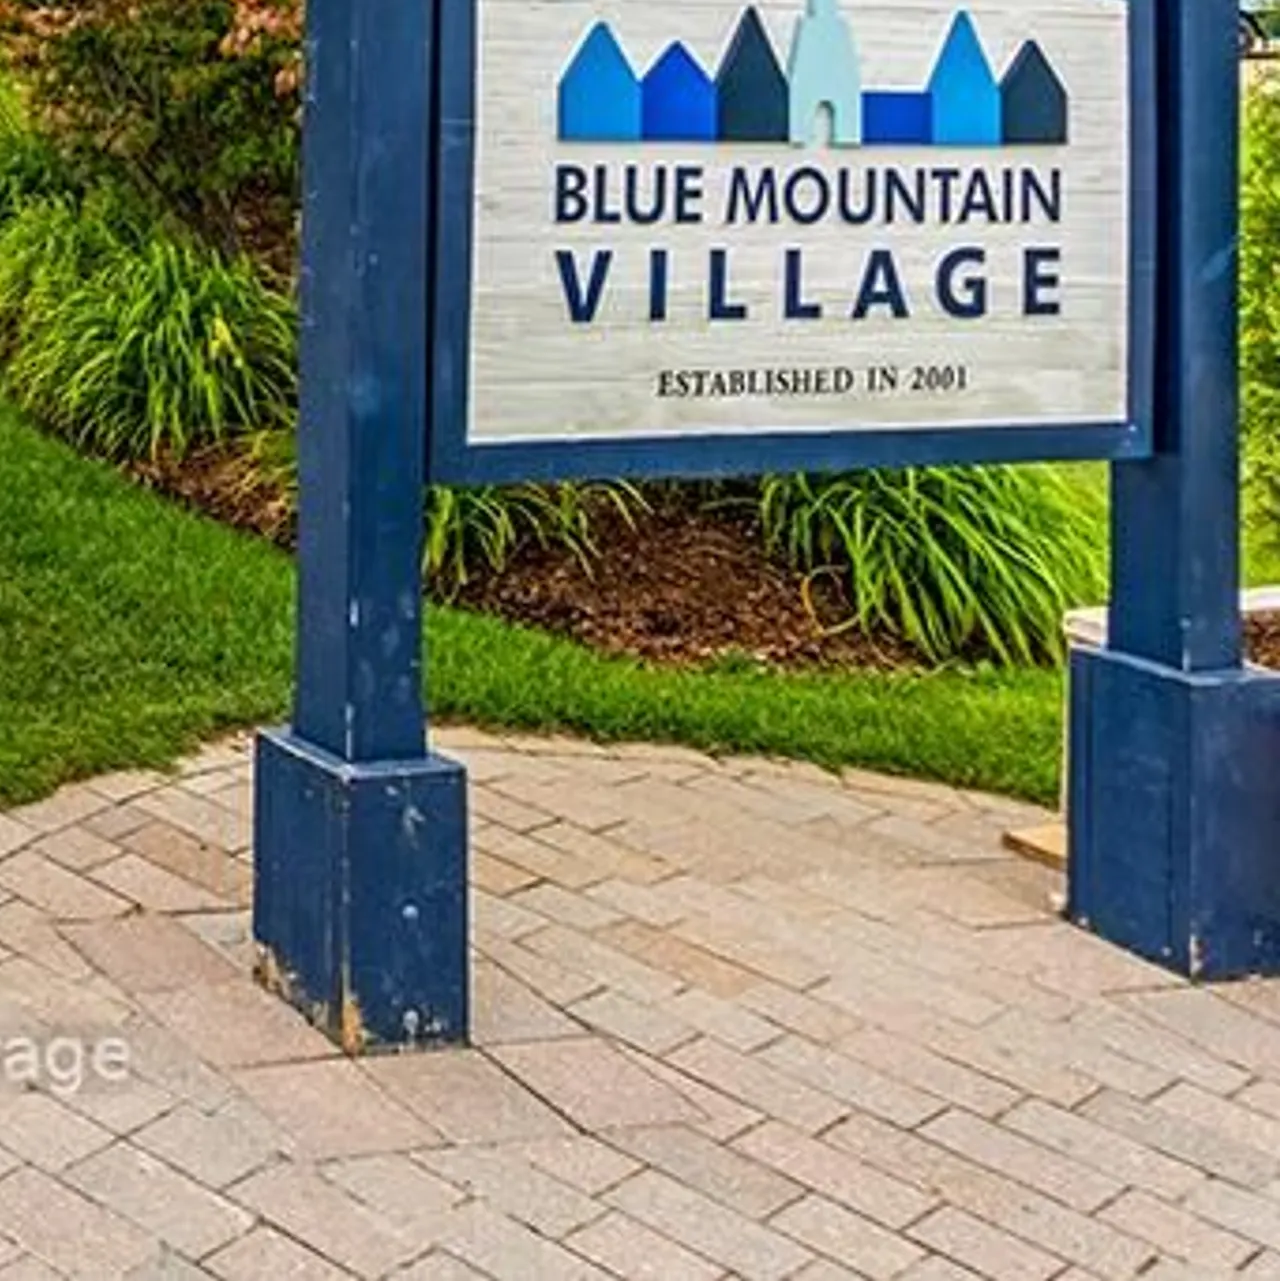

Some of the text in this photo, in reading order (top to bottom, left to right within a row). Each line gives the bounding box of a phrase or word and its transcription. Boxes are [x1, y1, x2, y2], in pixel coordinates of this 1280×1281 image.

[554, 166, 1061, 224] BLUE MOUNTAIN
[554, 247, 1062, 323] VILLAGE
[657, 365, 968, 397] ESTABLISHED IN 2001
